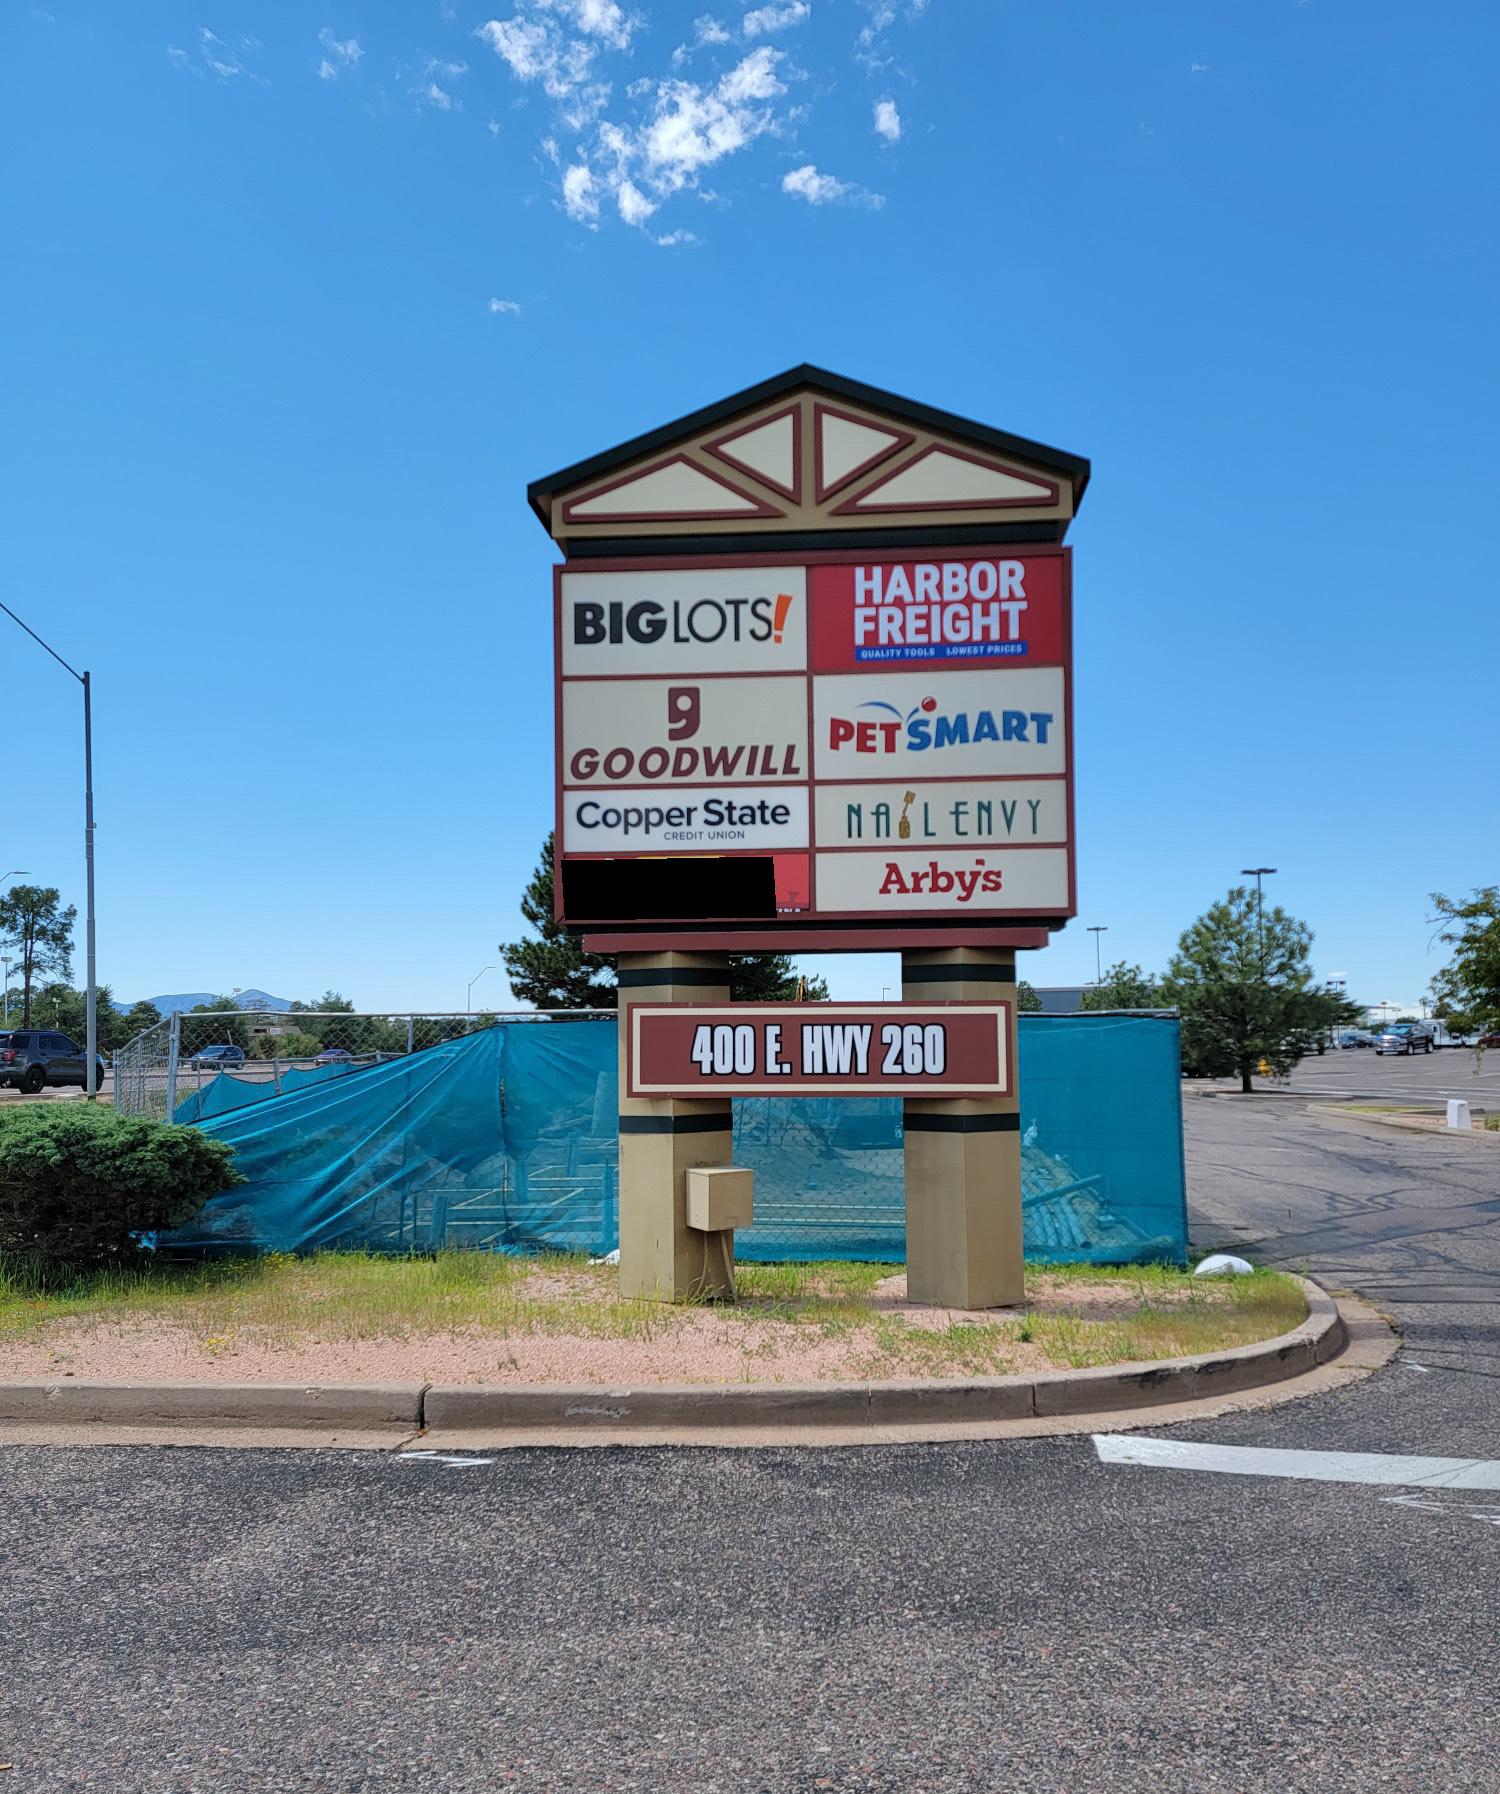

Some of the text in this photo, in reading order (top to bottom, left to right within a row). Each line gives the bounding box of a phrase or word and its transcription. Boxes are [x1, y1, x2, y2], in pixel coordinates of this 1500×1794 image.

[854, 560, 1026, 606] HARBOR
[854, 601, 1028, 646] FREIGHT
[861, 645, 1023, 659] QUALITY TOOLS LOWEST PRICES
[570, 744, 801, 780] GOODWILL
[576, 798, 791, 835] Copper State
[949, 799, 1042, 836] ENVY
[663, 831, 745, 841] CREDIT UNION
[879, 859, 1003, 902] Arby's
[690, 1023, 947, 1076] 400 E. HWY 260
